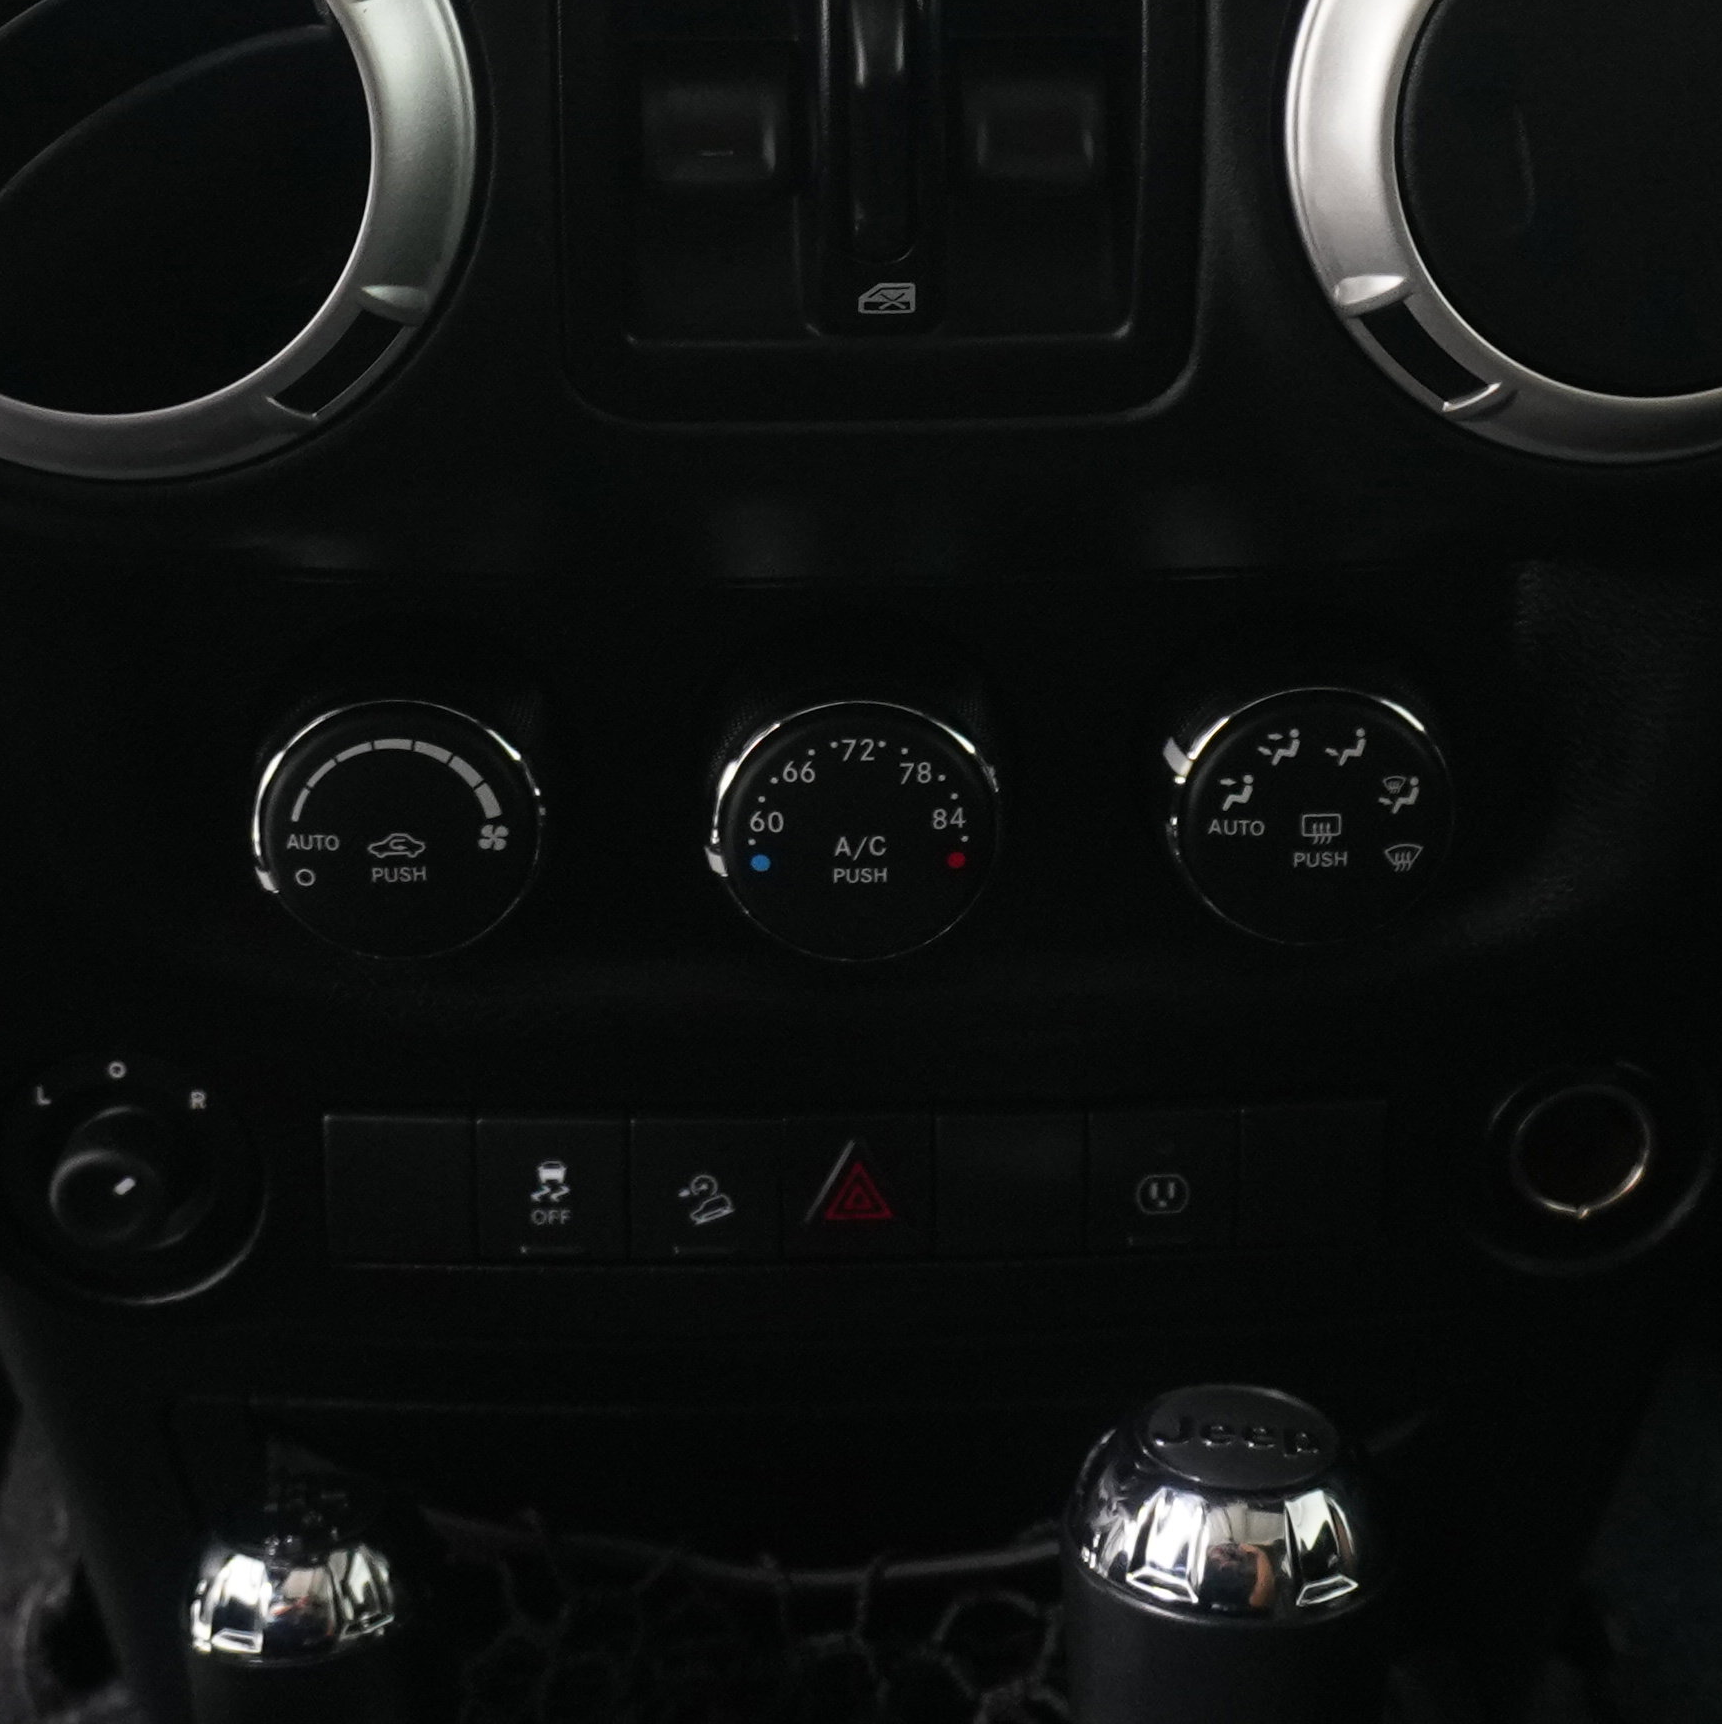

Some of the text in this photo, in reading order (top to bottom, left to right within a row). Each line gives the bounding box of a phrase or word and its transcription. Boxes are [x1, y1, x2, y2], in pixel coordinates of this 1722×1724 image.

[841, 739, 875, 762] 72
[782, 761, 816, 784] 66
[899, 762, 932, 785] 78
[750, 812, 784, 833] 60
[932, 807, 966, 830] 84
[1207, 819, 1265, 837] AUTO
[286, 834, 340, 852] AUTO
[834, 836, 887, 861] A/C
[1293, 850, 1348, 868] PUSH
[371, 866, 427, 883] PUSH
[833, 867, 888, 884] PUSH
[530, 1208, 572, 1226] OFF
